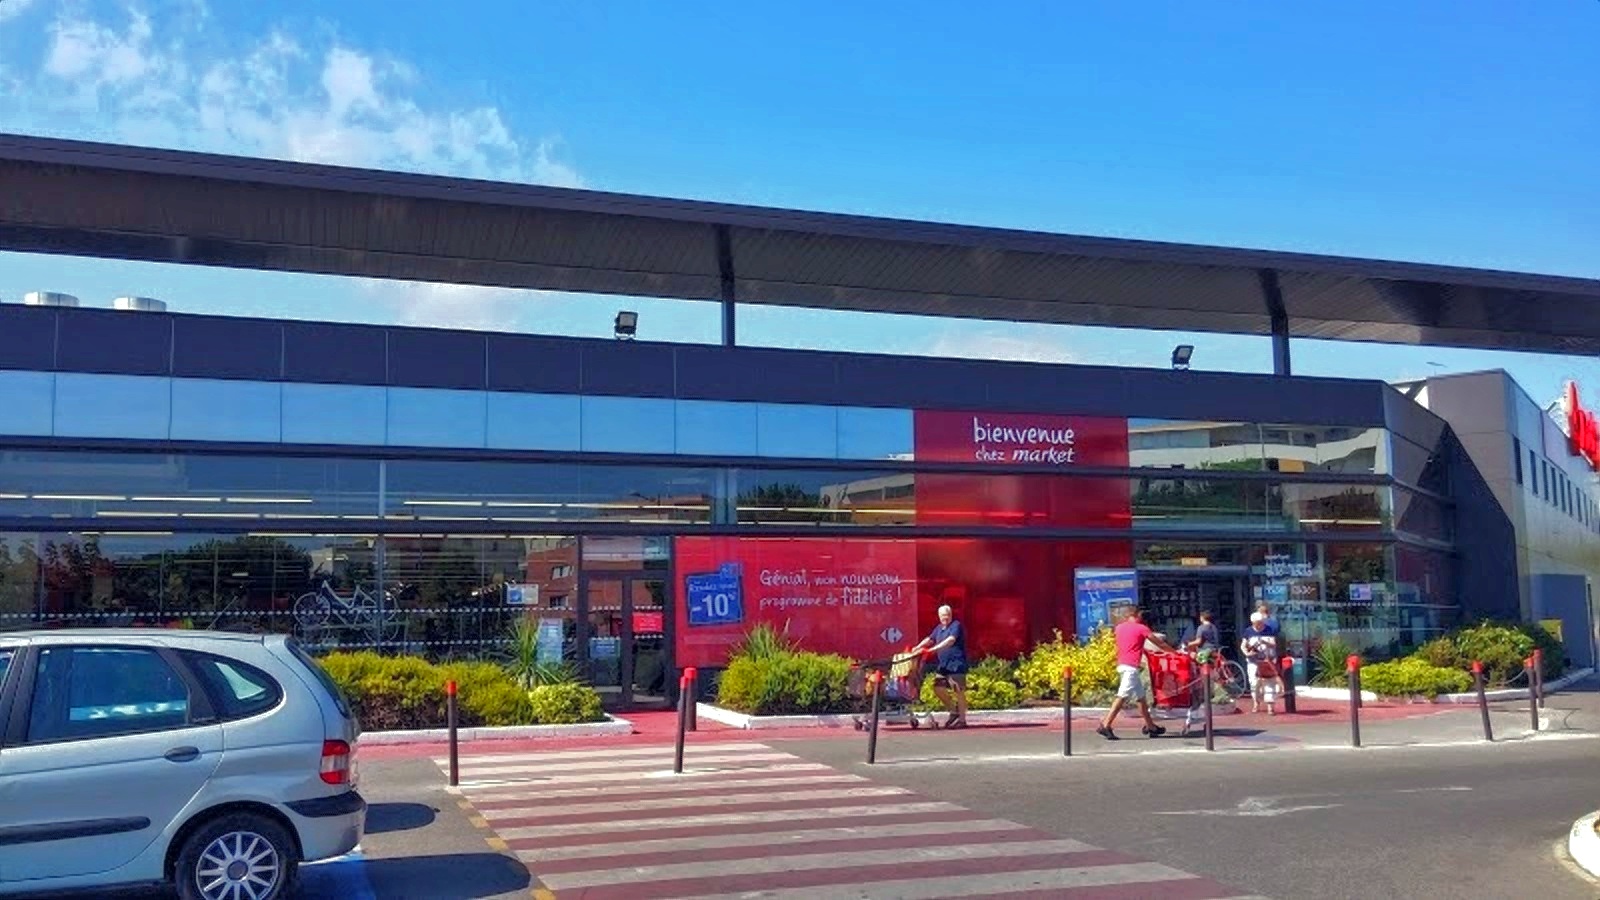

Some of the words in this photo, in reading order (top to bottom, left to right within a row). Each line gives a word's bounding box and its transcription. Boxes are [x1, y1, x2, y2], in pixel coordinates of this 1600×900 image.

[973, 416, 1075, 444] bienvenue
[975, 445, 1005, 461] chez
[1011, 447, 1075, 464] market
[759, 569, 811, 588] Génial,
[841, 573, 901, 585] nouveau
[759, 594, 821, 611] programme
[825, 592, 838, 606] de
[840, 586, 893, 606] fidélité
